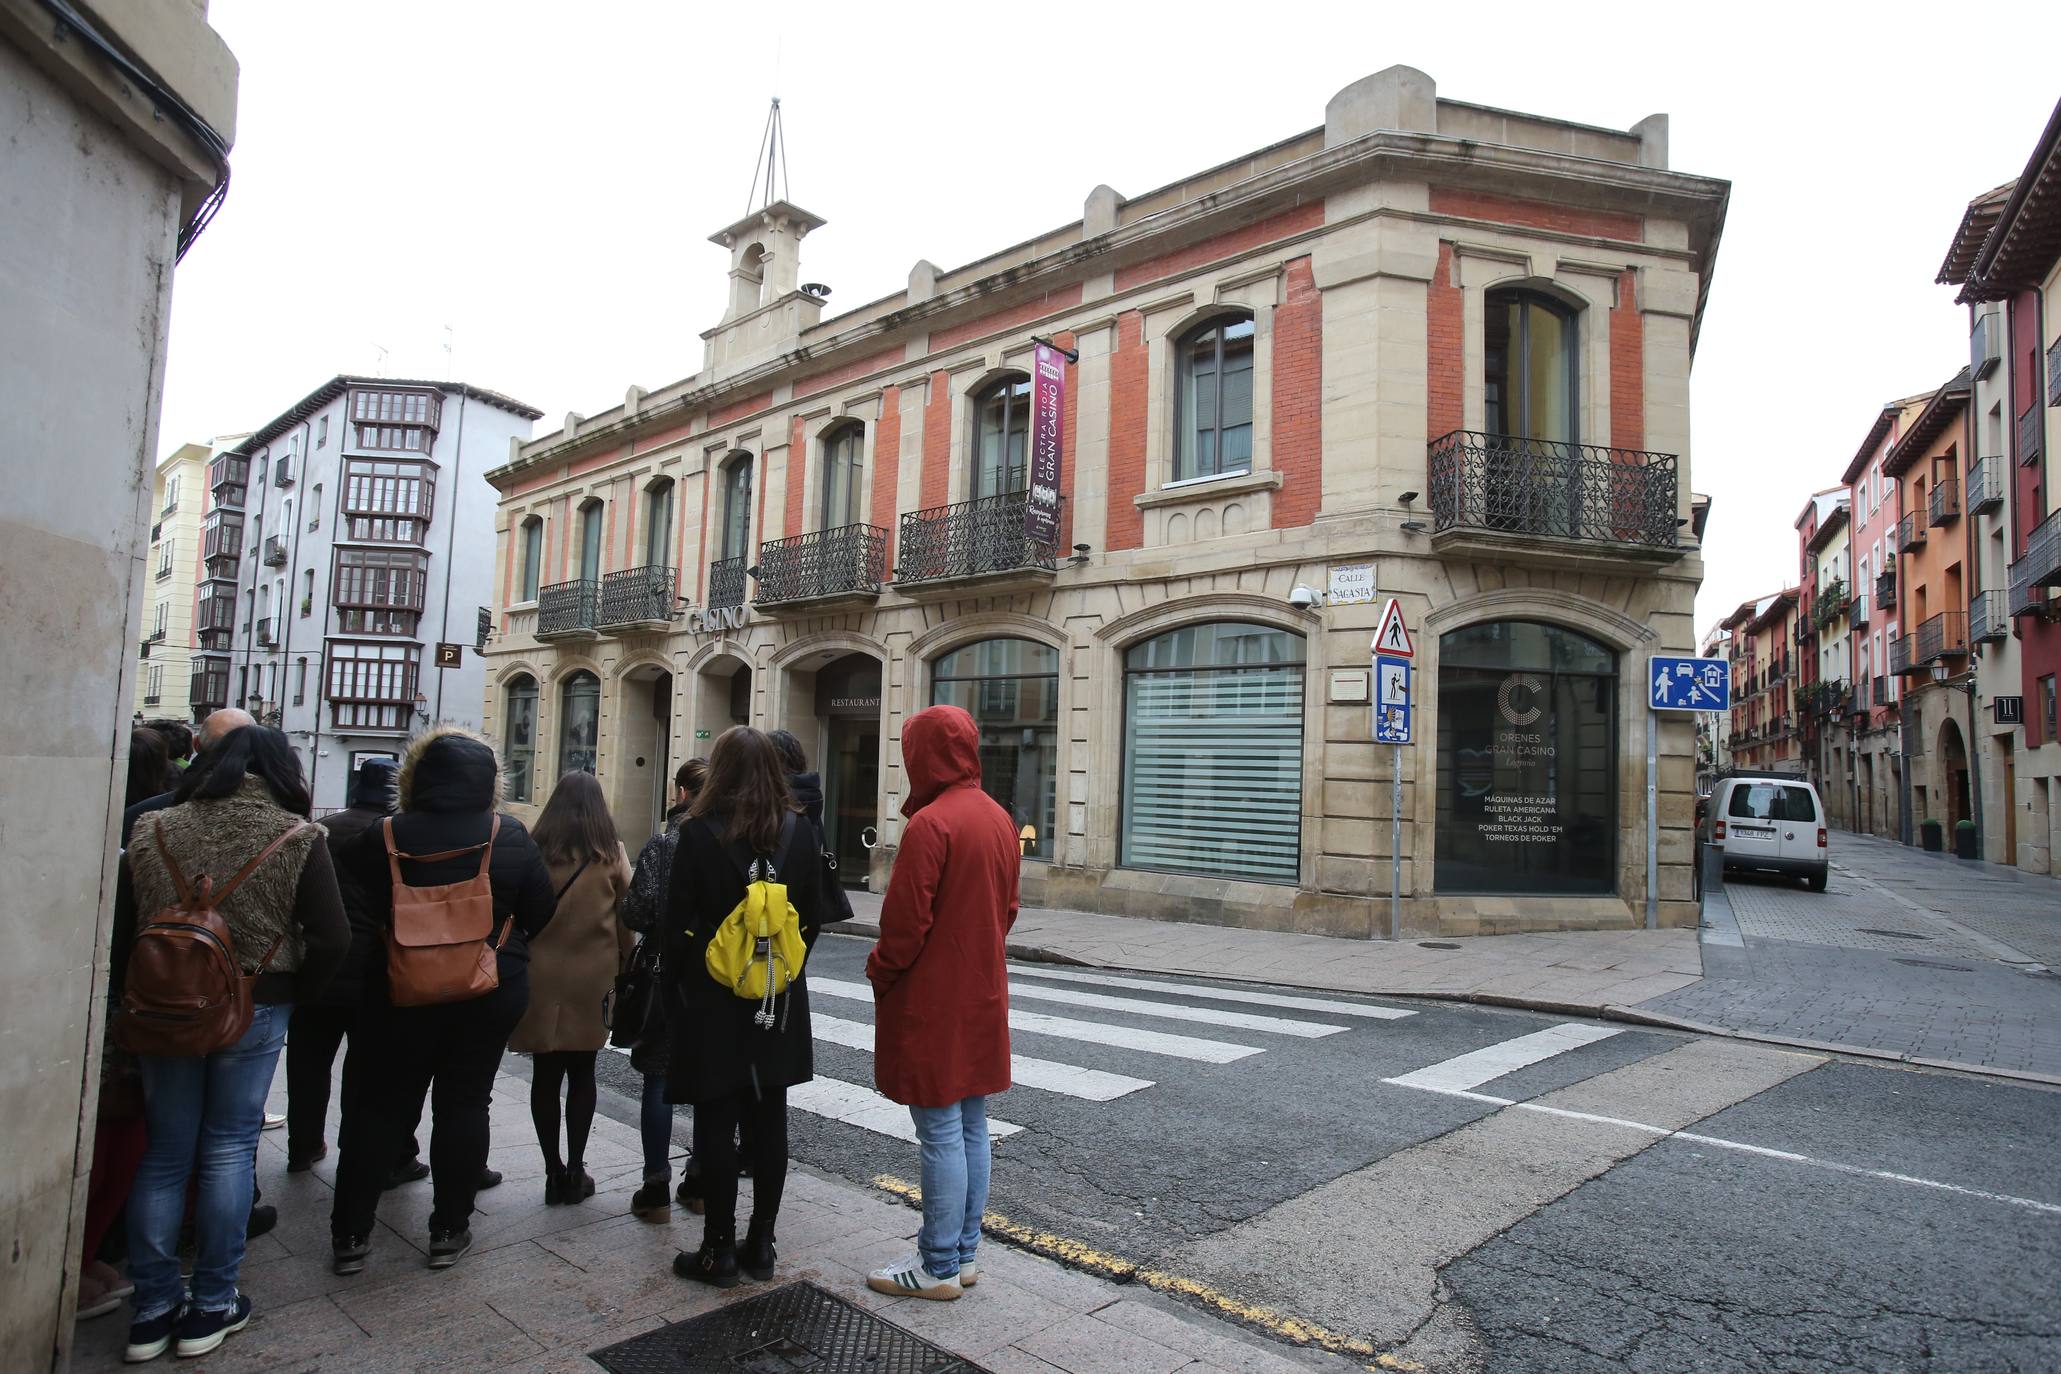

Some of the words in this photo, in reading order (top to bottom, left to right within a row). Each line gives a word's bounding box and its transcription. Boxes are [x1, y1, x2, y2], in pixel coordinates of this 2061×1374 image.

[1048, 384, 1058, 437] CASINO
[1038, 424, 1047, 478] ELECTRA
[1045, 440, 1056, 481] GRAN
[1338, 574, 1366, 583] CALLE
[1332, 587, 1370, 599] SAGASTA
[687, 604, 750, 635] CASINO
[444, 651, 454, 661] P
[831, 698, 881, 707] RESTAURANT
[1500, 733, 1541, 743] ORENES
[1485, 744, 1514, 754] GRAN
[1517, 746, 1556, 756] CASINO
[1484, 794, 1523, 804] MÁQUINAS
[1535, 797, 1556, 805] AZAR
[1484, 805, 1512, 813] RULETA
[1513, 806, 1556, 814] AMERICANA
